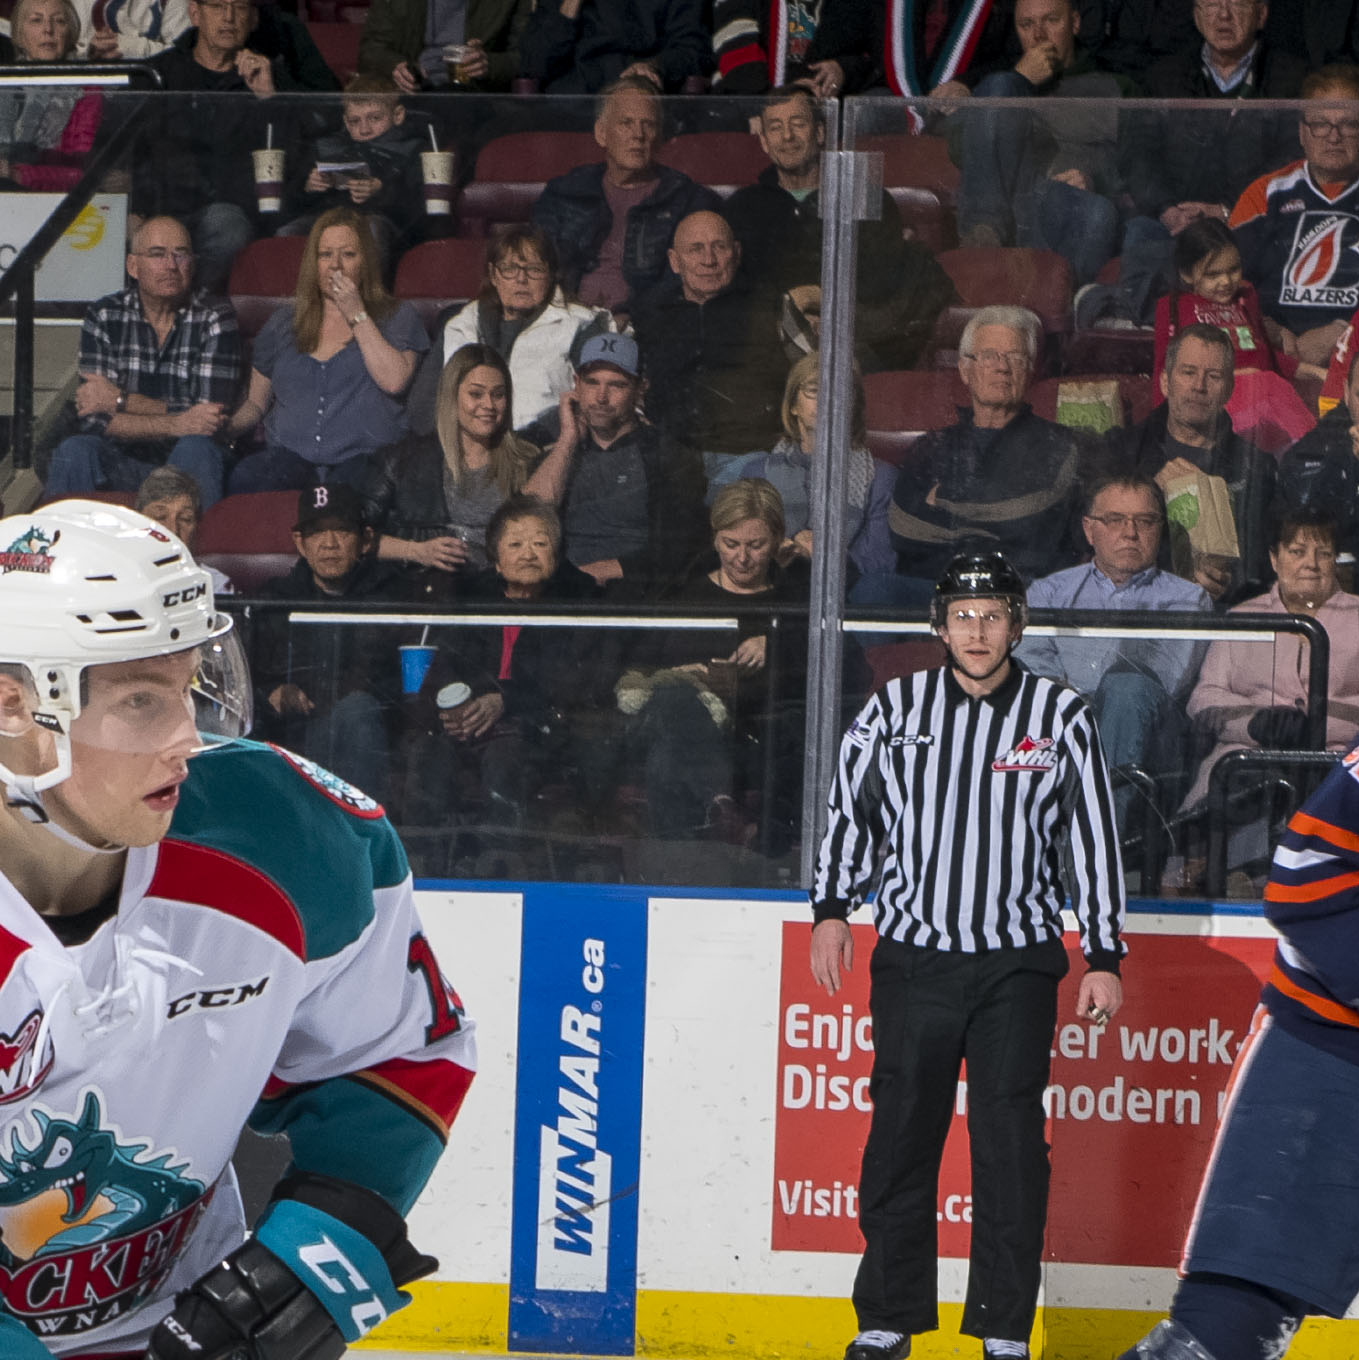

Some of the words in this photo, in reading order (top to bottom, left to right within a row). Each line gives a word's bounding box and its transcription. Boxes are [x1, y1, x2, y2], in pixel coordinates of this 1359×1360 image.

[1283, 288, 1357, 305] BLAZERS
[313, 487, 329, 508] B
[163, 583, 207, 609] CCM
[889, 734, 935, 747] CCM
[1004, 749, 1059, 768] WHL
[167, 976, 271, 1019] CCM
[784, 1003, 875, 1062] Enjo
[778, 1180, 858, 1219] Visit
